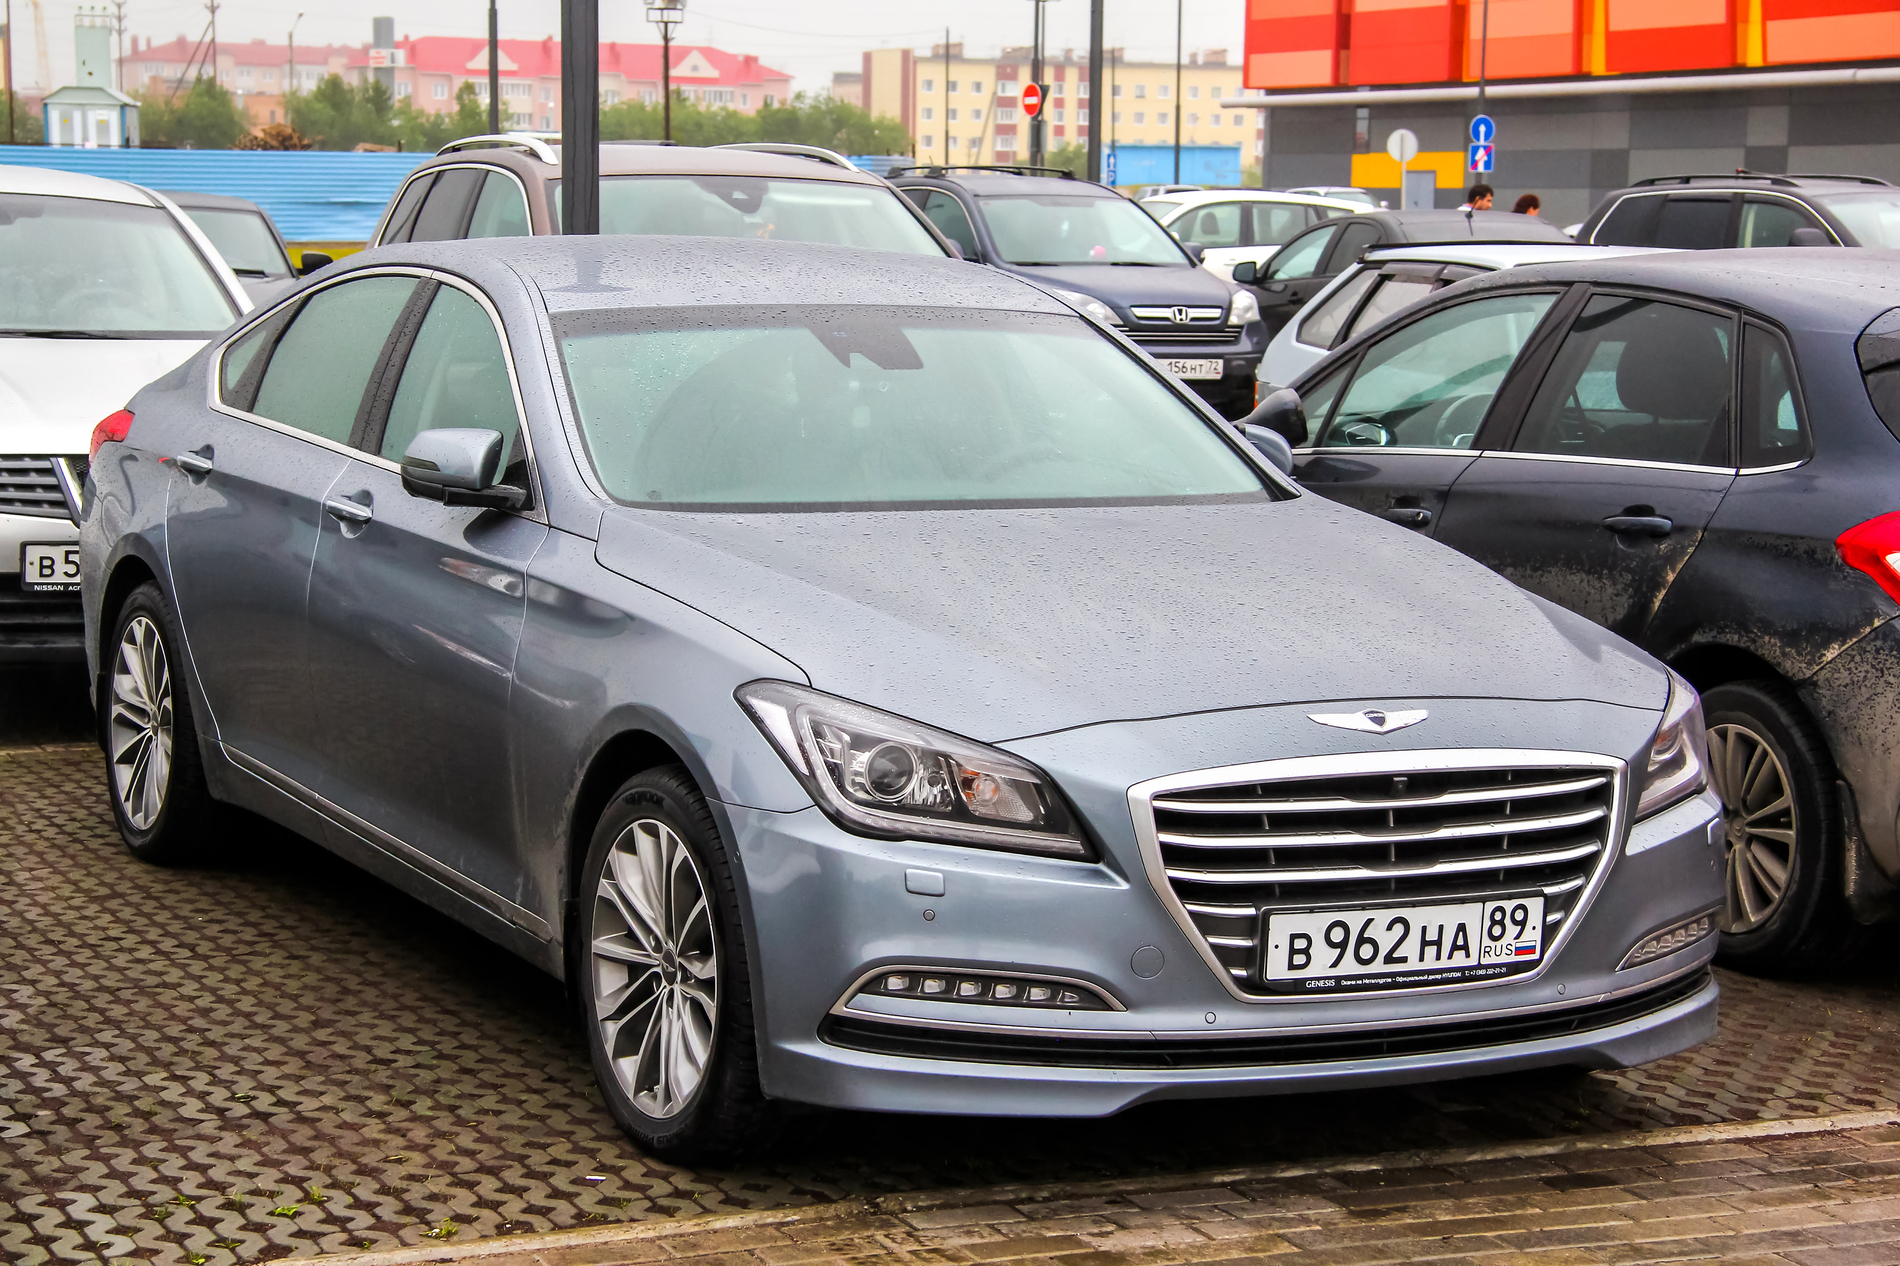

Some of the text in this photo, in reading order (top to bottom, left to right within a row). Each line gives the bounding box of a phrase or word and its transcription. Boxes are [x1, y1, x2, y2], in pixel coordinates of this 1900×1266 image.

[1208, 360, 1219, 371] 72
[1486, 903, 1530, 942] 89
[1482, 943, 1513, 959] RUS
[1305, 979, 1336, 988] GENESIS
